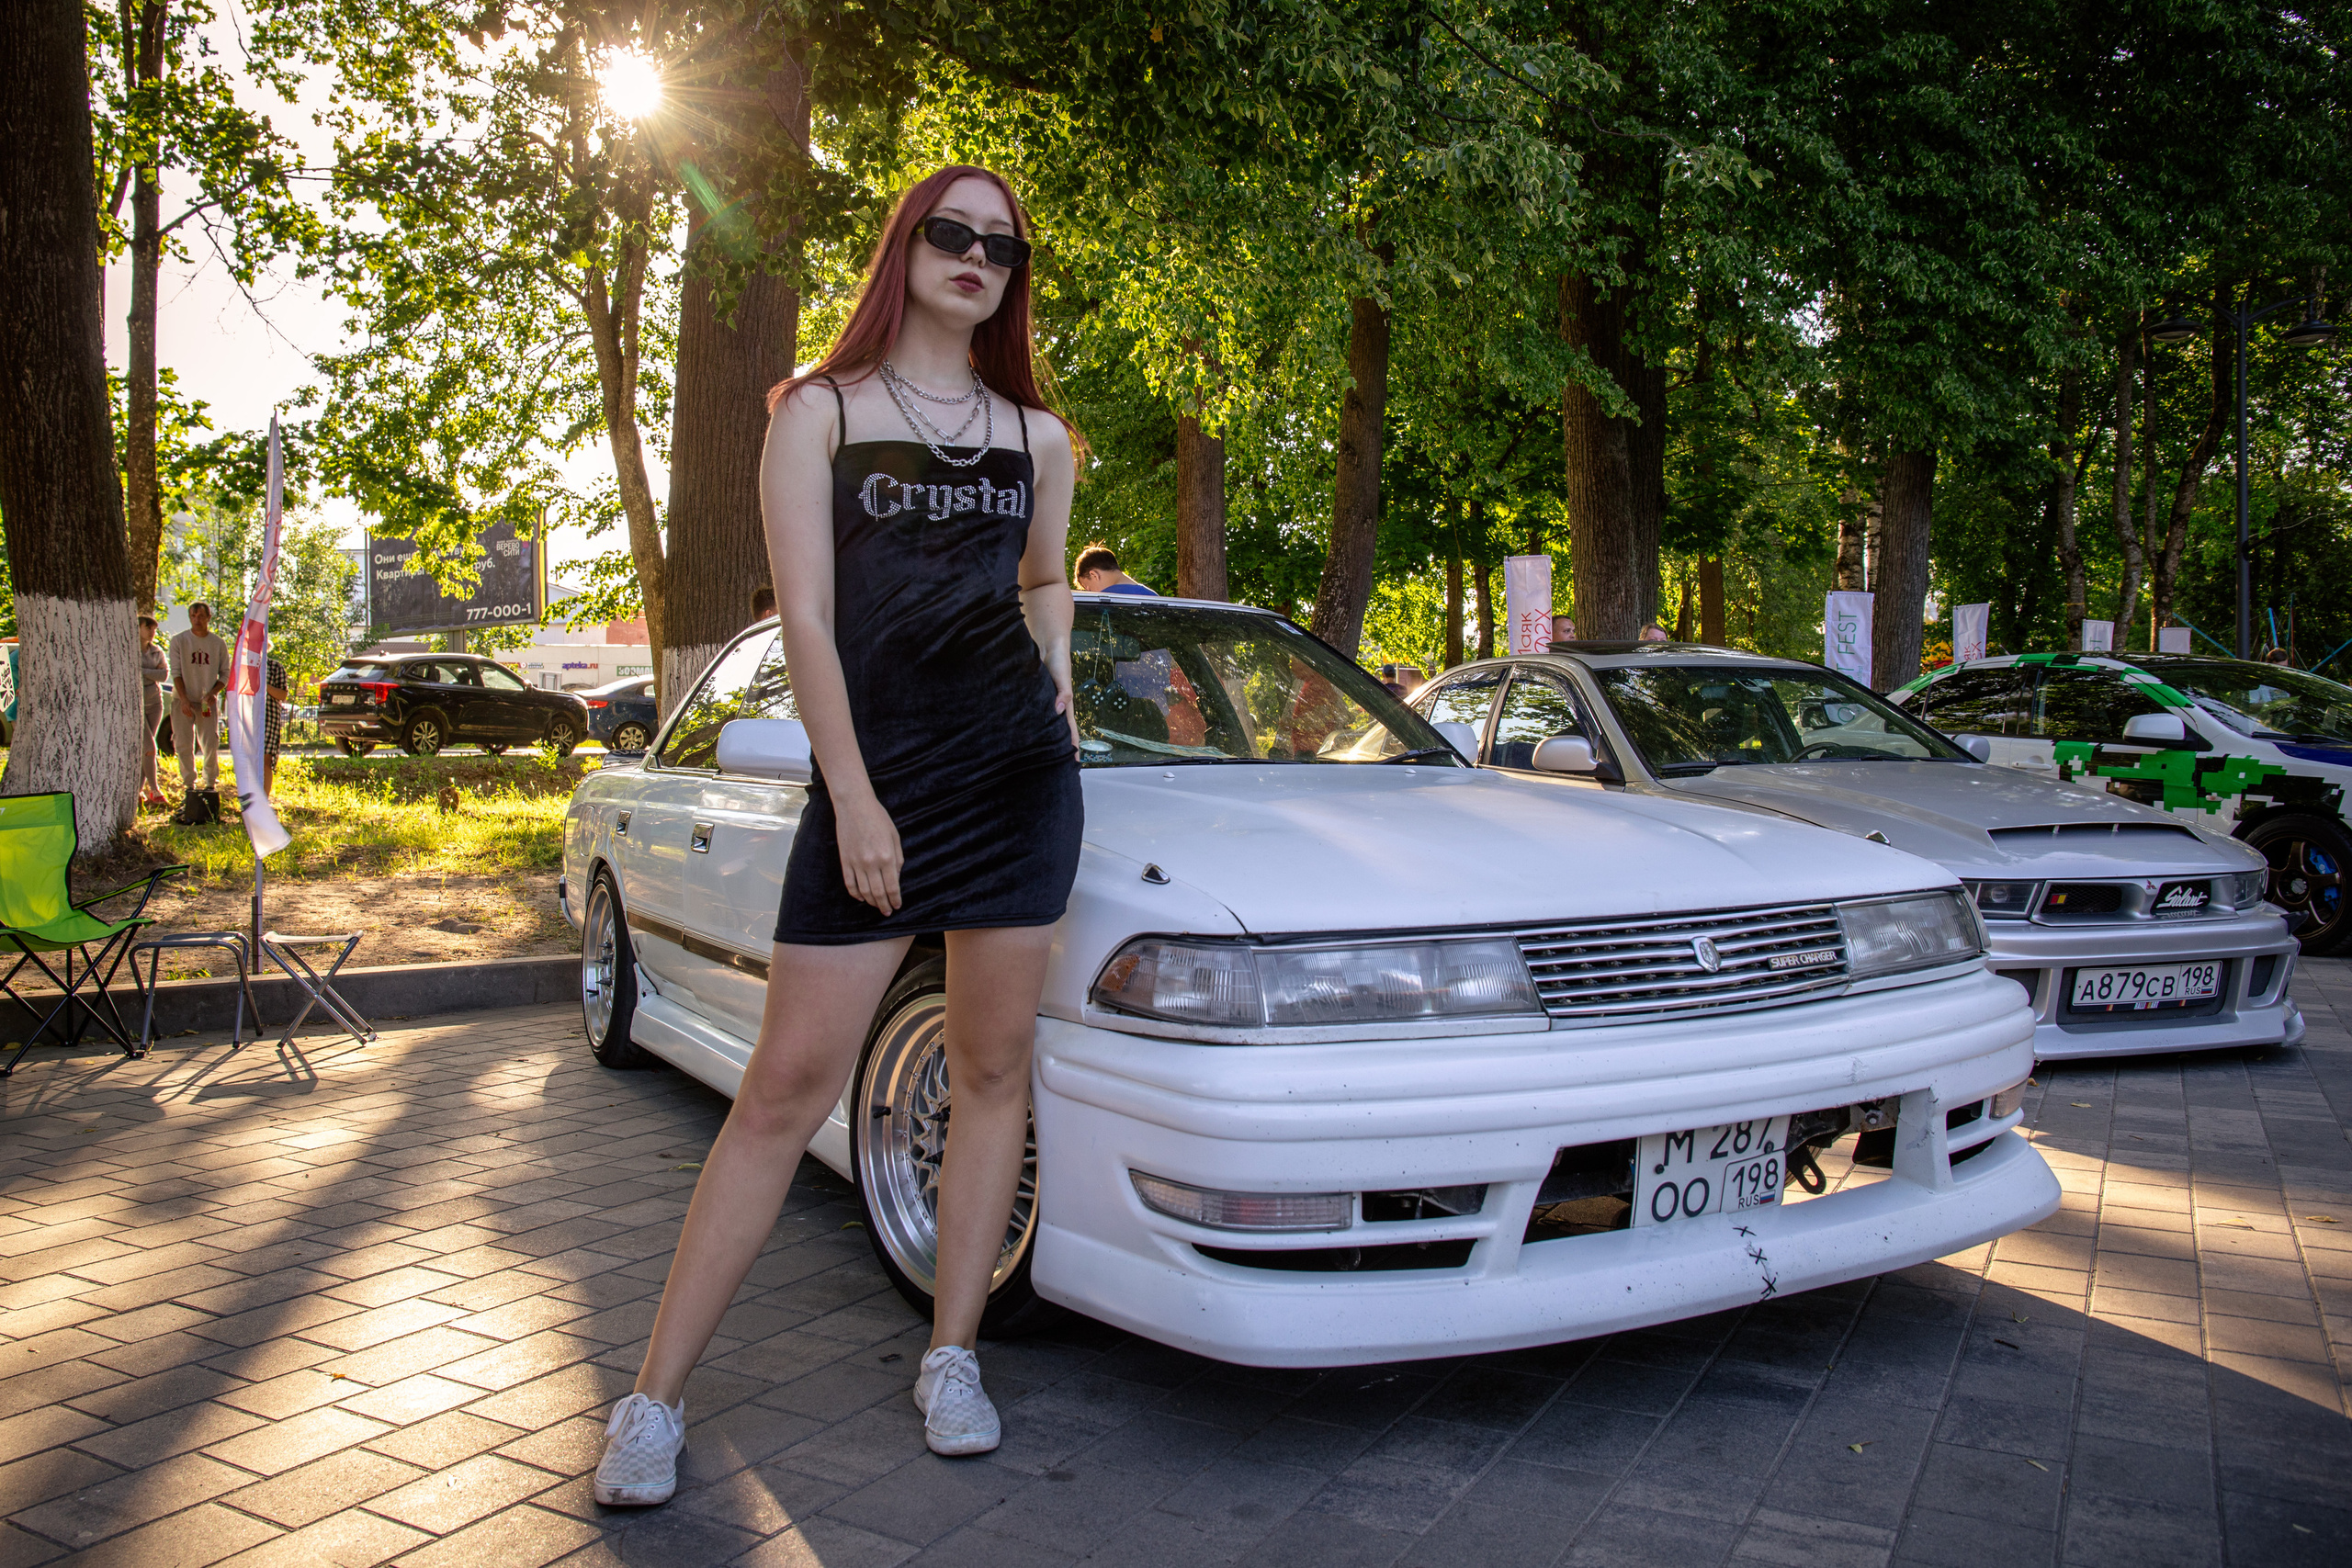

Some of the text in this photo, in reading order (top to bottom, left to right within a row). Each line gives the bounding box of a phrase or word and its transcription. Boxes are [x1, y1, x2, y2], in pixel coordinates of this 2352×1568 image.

[858, 472, 1026, 521] Crystal
[374, 553, 395, 565] Они
[466, 602, 532, 621] 777-000-1
[1838, 610, 1858, 655] FEST
[561, 661, 599, 671] apteka.ru
[2156, 886, 2208, 908] Galant
[1770, 950, 1838, 968] SUPER CHARGER
[2182, 966, 2213, 987] 198
[2185, 987, 2201, 996] RUS
[1733, 1158, 1779, 1198] 198
[1737, 1194, 1759, 1209] RUS
